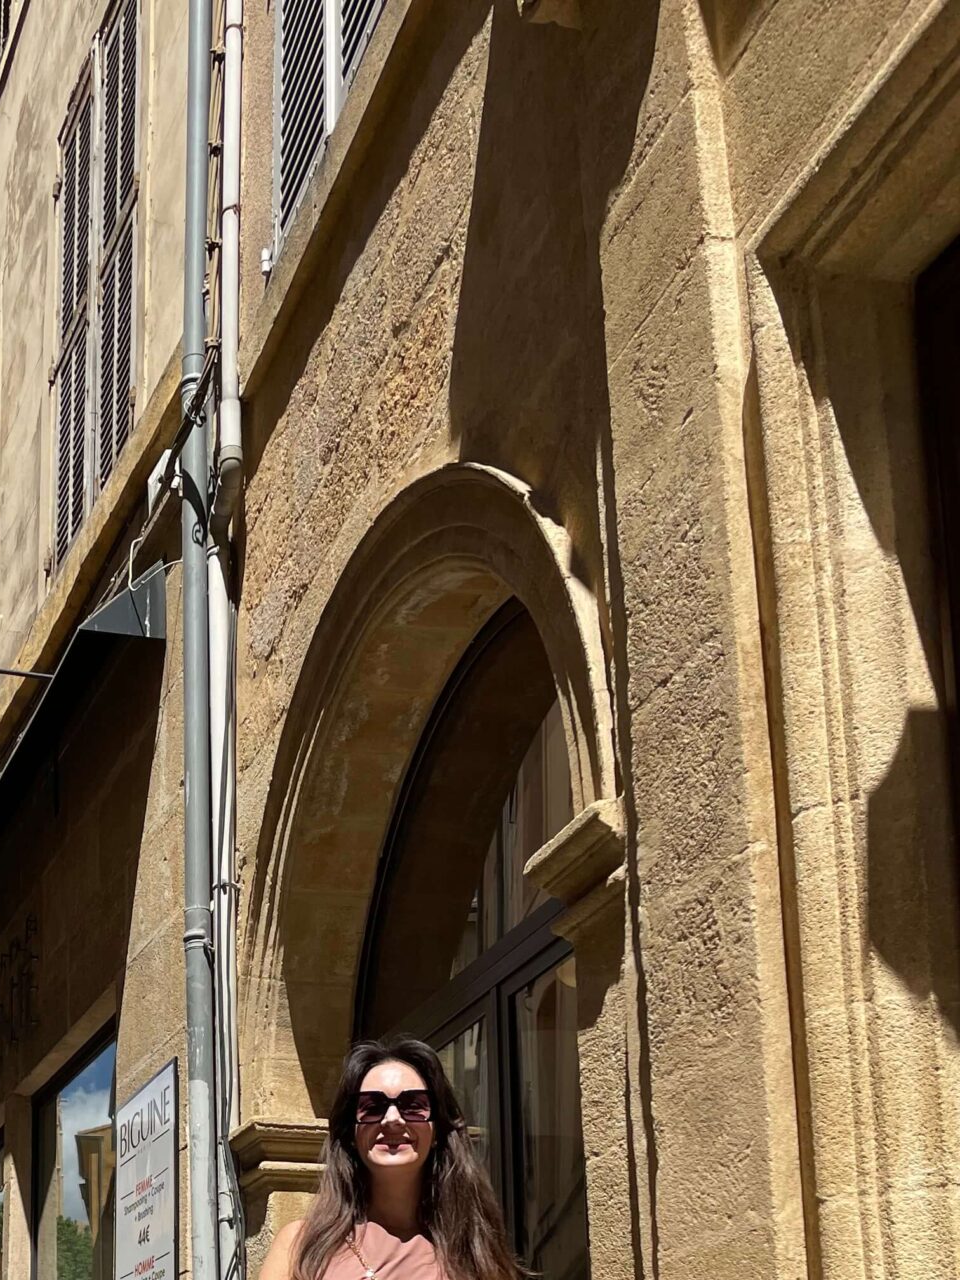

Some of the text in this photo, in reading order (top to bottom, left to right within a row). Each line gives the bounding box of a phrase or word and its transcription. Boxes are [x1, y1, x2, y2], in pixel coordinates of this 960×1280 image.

[120, 1085, 170, 1158] BIGUINE
[136, 1174, 152, 1197] FEMME
[124, 1194, 147, 1216] Shampooing
[151, 1181, 164, 1197] Coupe
[138, 1204, 153, 1222] Brushing
[138, 1224, 150, 1246] 44€
[135, 1255, 154, 1277] HOMME
